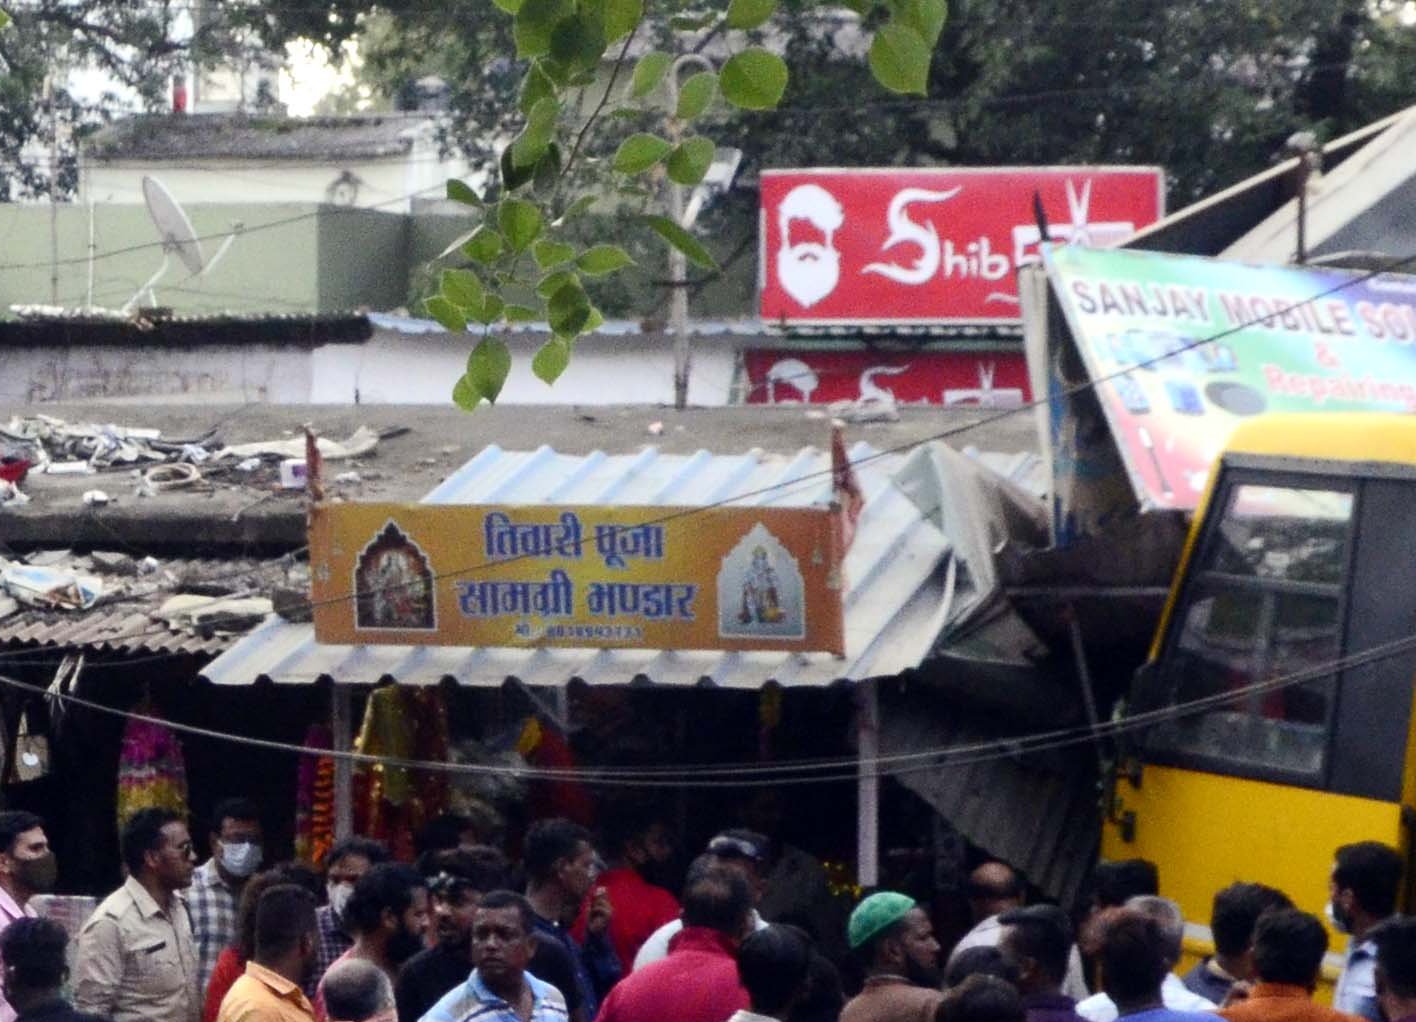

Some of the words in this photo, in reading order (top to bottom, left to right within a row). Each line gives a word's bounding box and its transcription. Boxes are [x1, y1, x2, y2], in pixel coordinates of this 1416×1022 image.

[1071, 279, 1210, 322] SANJAY
[1218, 292, 1355, 337] MOBILE
[484, 511, 583, 557] तिवारी
[594, 524, 665, 568] पूजा
[455, 568, 574, 616] सामग्री
[587, 582, 698, 619] भण्डार
